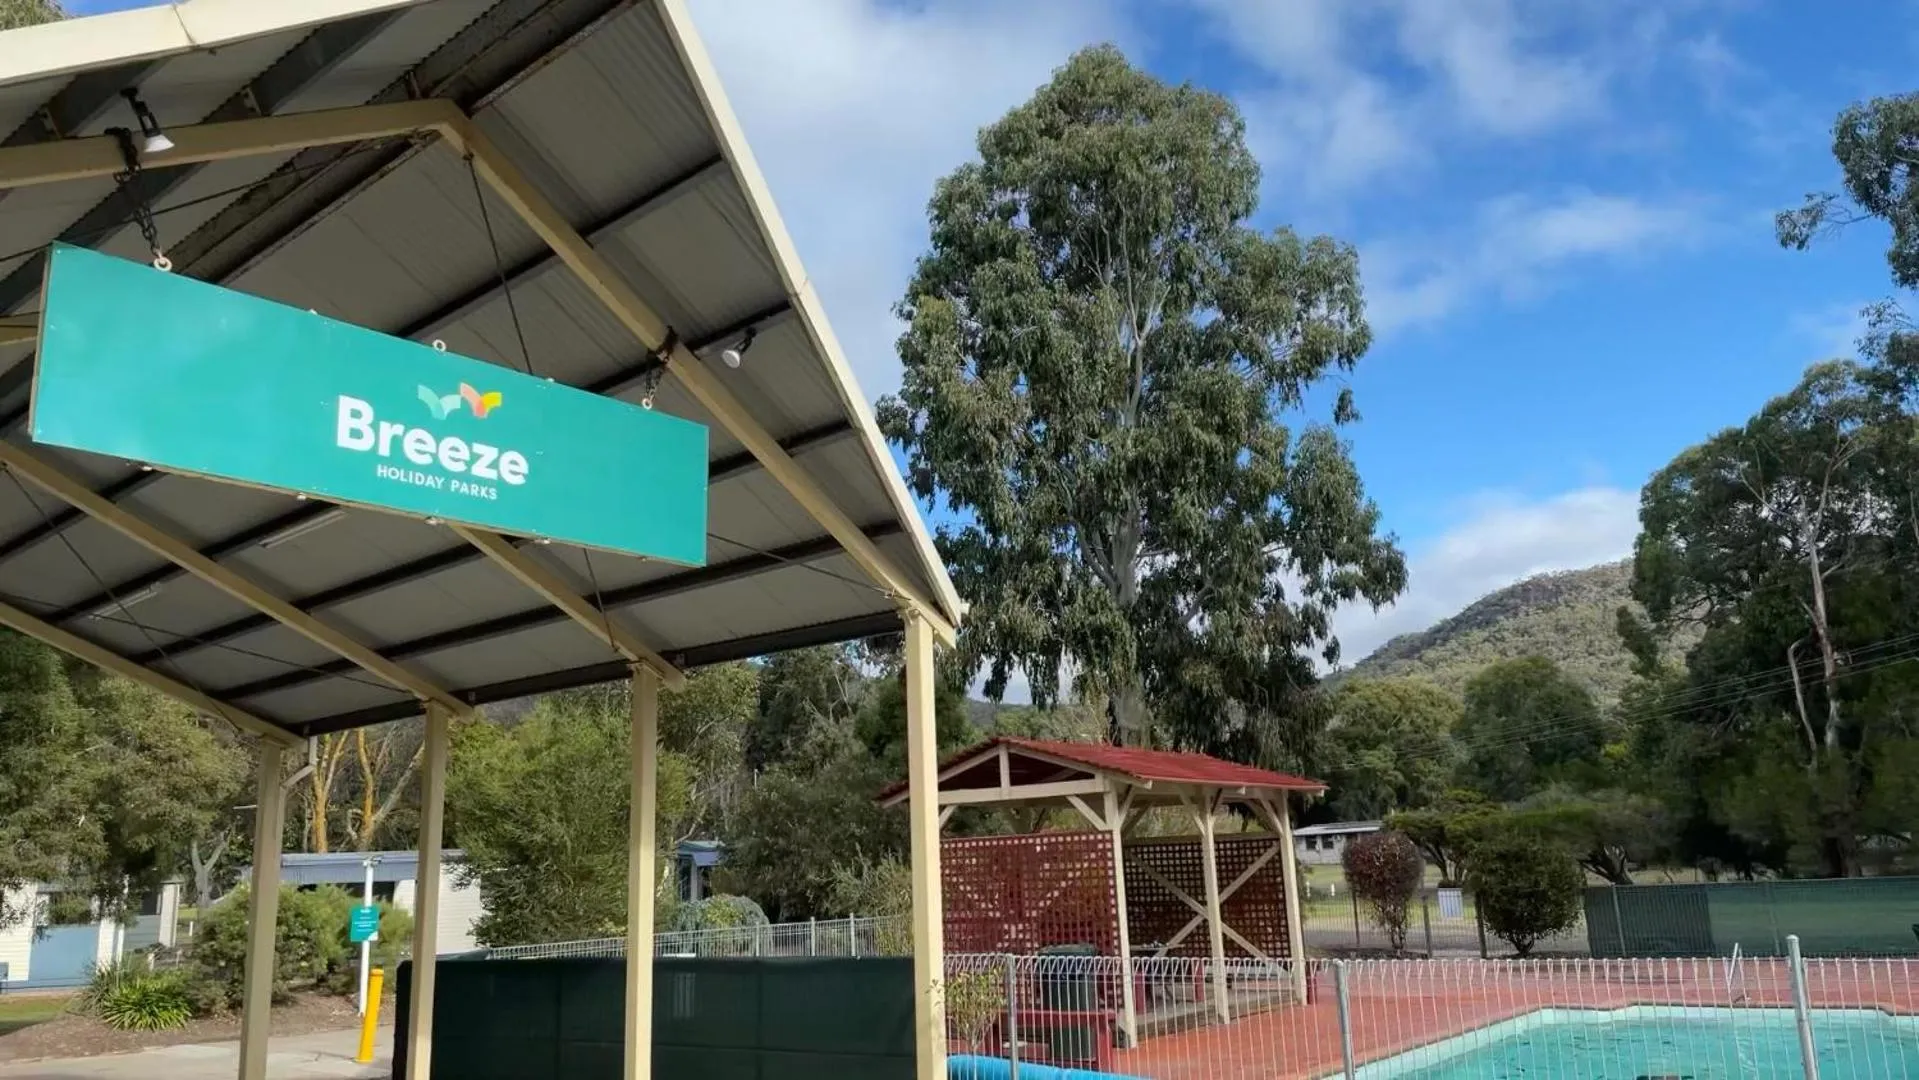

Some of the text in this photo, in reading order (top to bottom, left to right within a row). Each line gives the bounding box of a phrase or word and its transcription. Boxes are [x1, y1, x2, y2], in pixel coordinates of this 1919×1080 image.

[336, 394, 529, 485] Breeze
[377, 464, 498, 500] HOLIDAY PARKS
